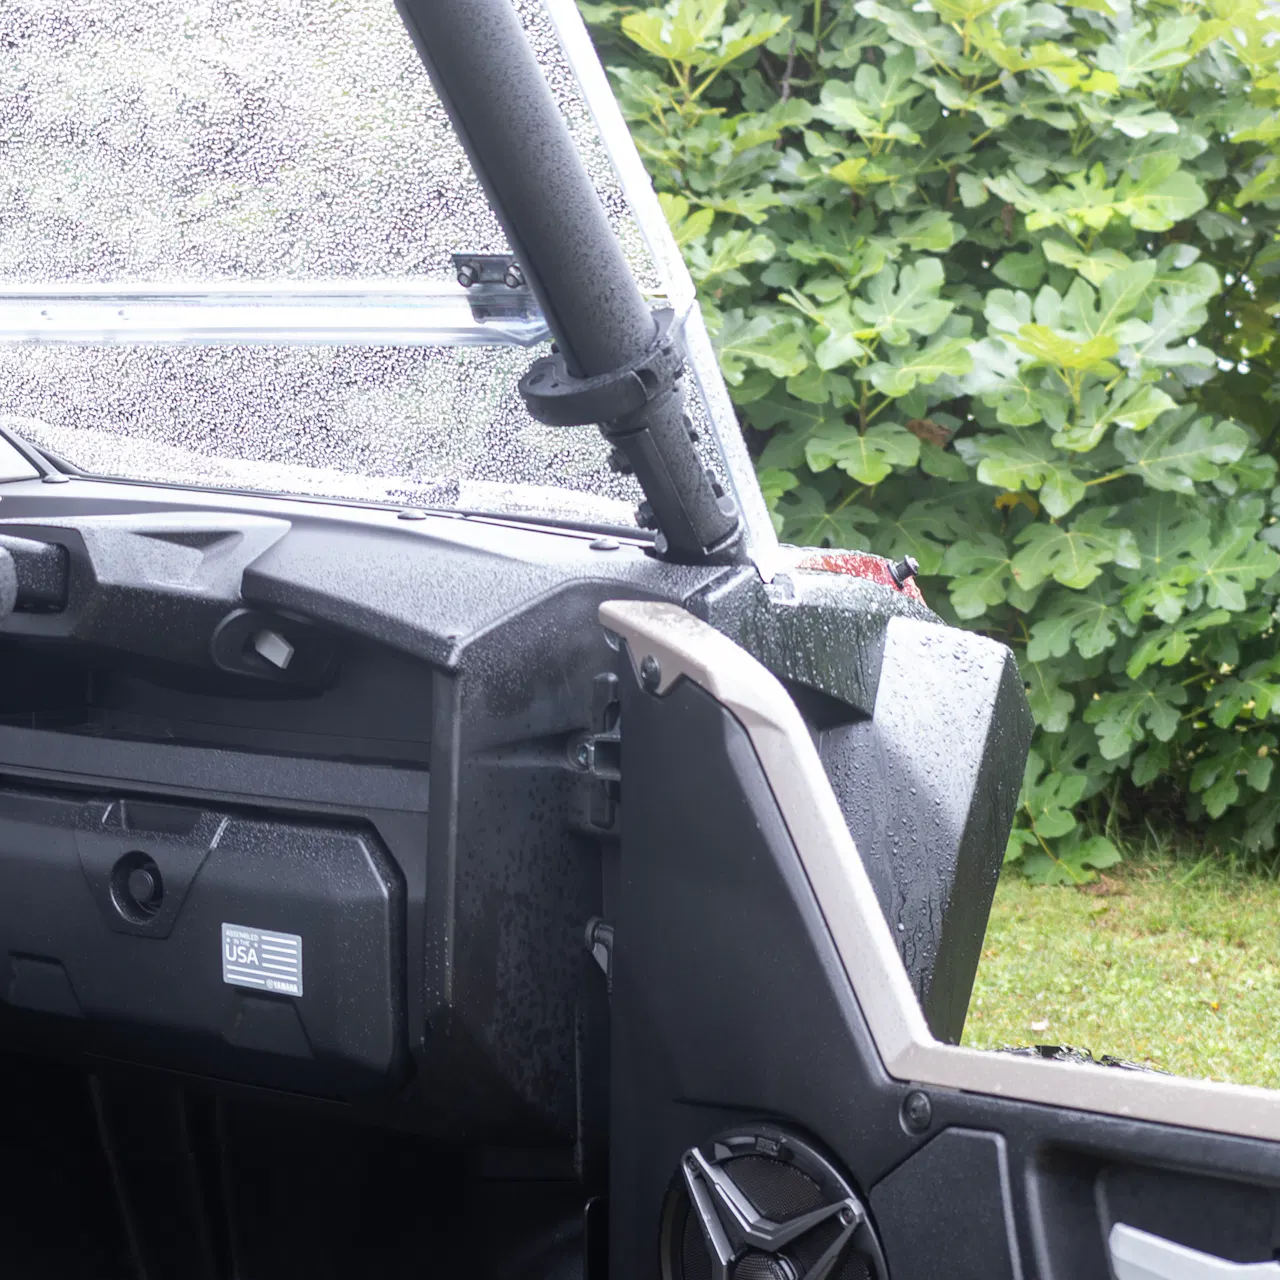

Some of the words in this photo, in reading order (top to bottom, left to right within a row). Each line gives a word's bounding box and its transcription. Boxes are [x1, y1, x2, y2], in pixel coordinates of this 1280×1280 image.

[225, 929, 259, 942] ASSEMBLED
[225, 943, 260, 966] USA
[273, 980, 298, 992] YAMAHA
